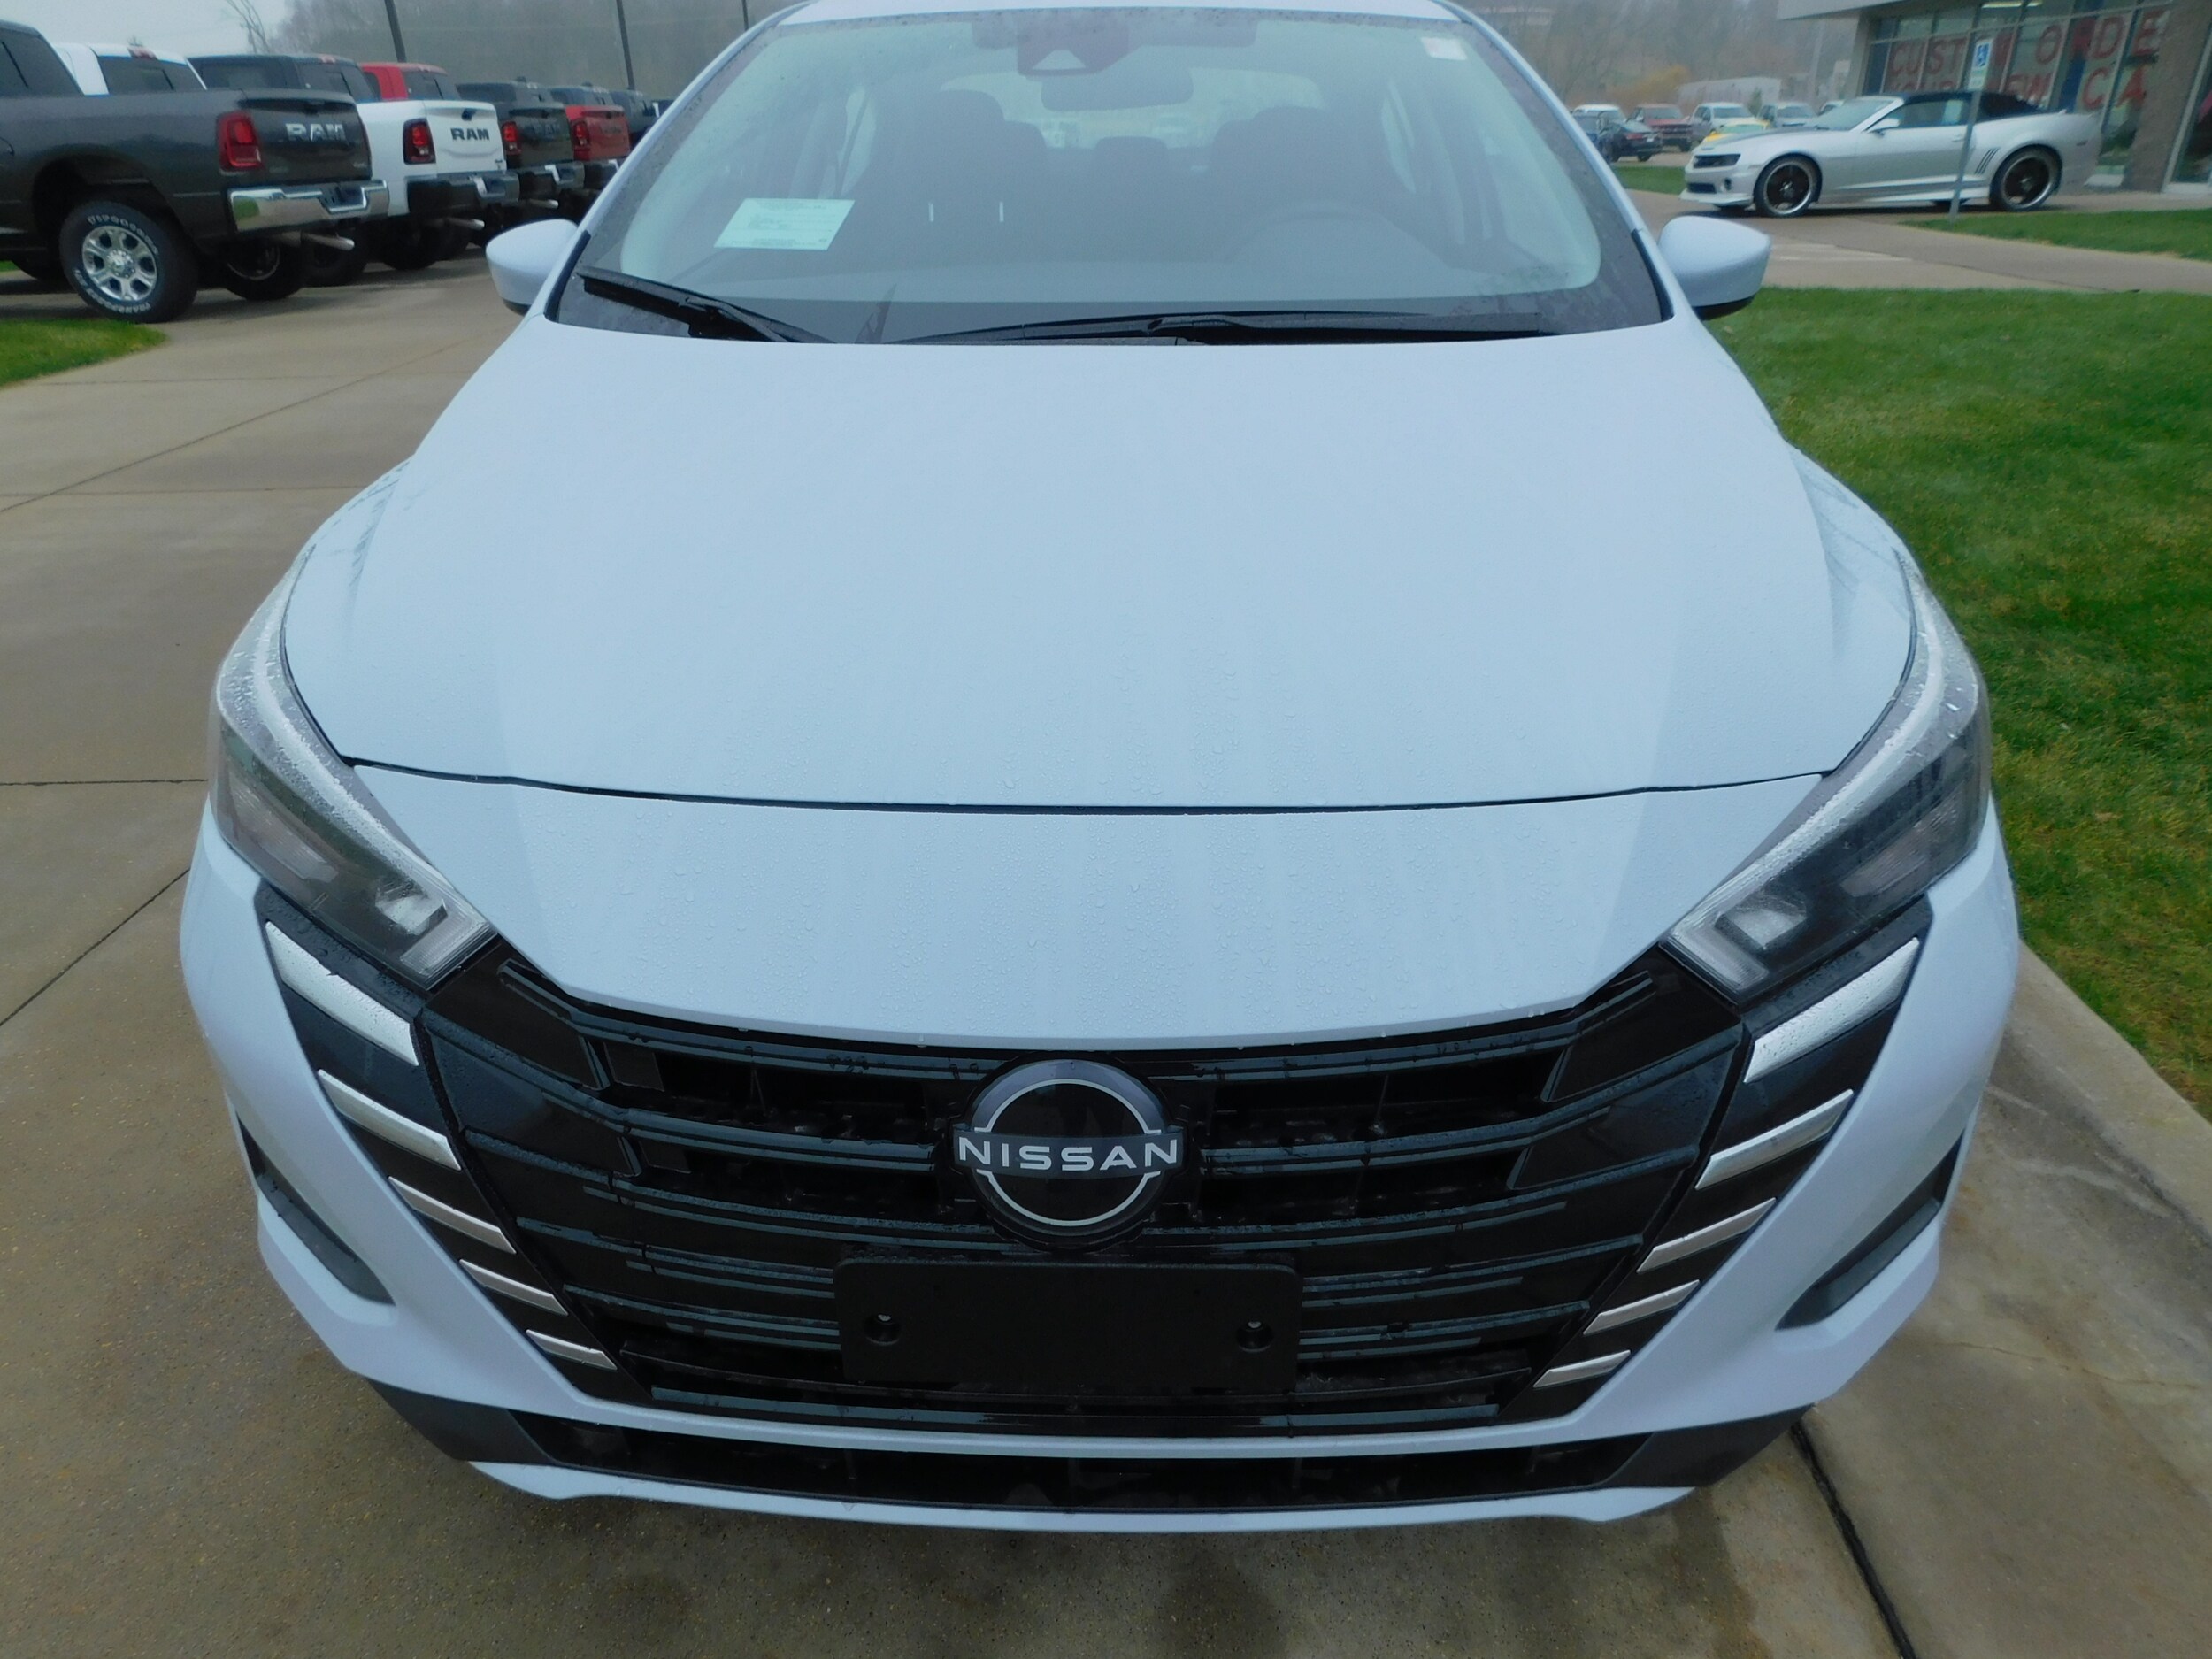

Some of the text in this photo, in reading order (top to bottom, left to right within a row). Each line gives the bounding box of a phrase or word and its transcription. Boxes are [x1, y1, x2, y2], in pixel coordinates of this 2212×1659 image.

[285, 123, 346, 141] RAM
[450, 127, 490, 141] RAM
[958, 1136, 1178, 1171] NISSAN
